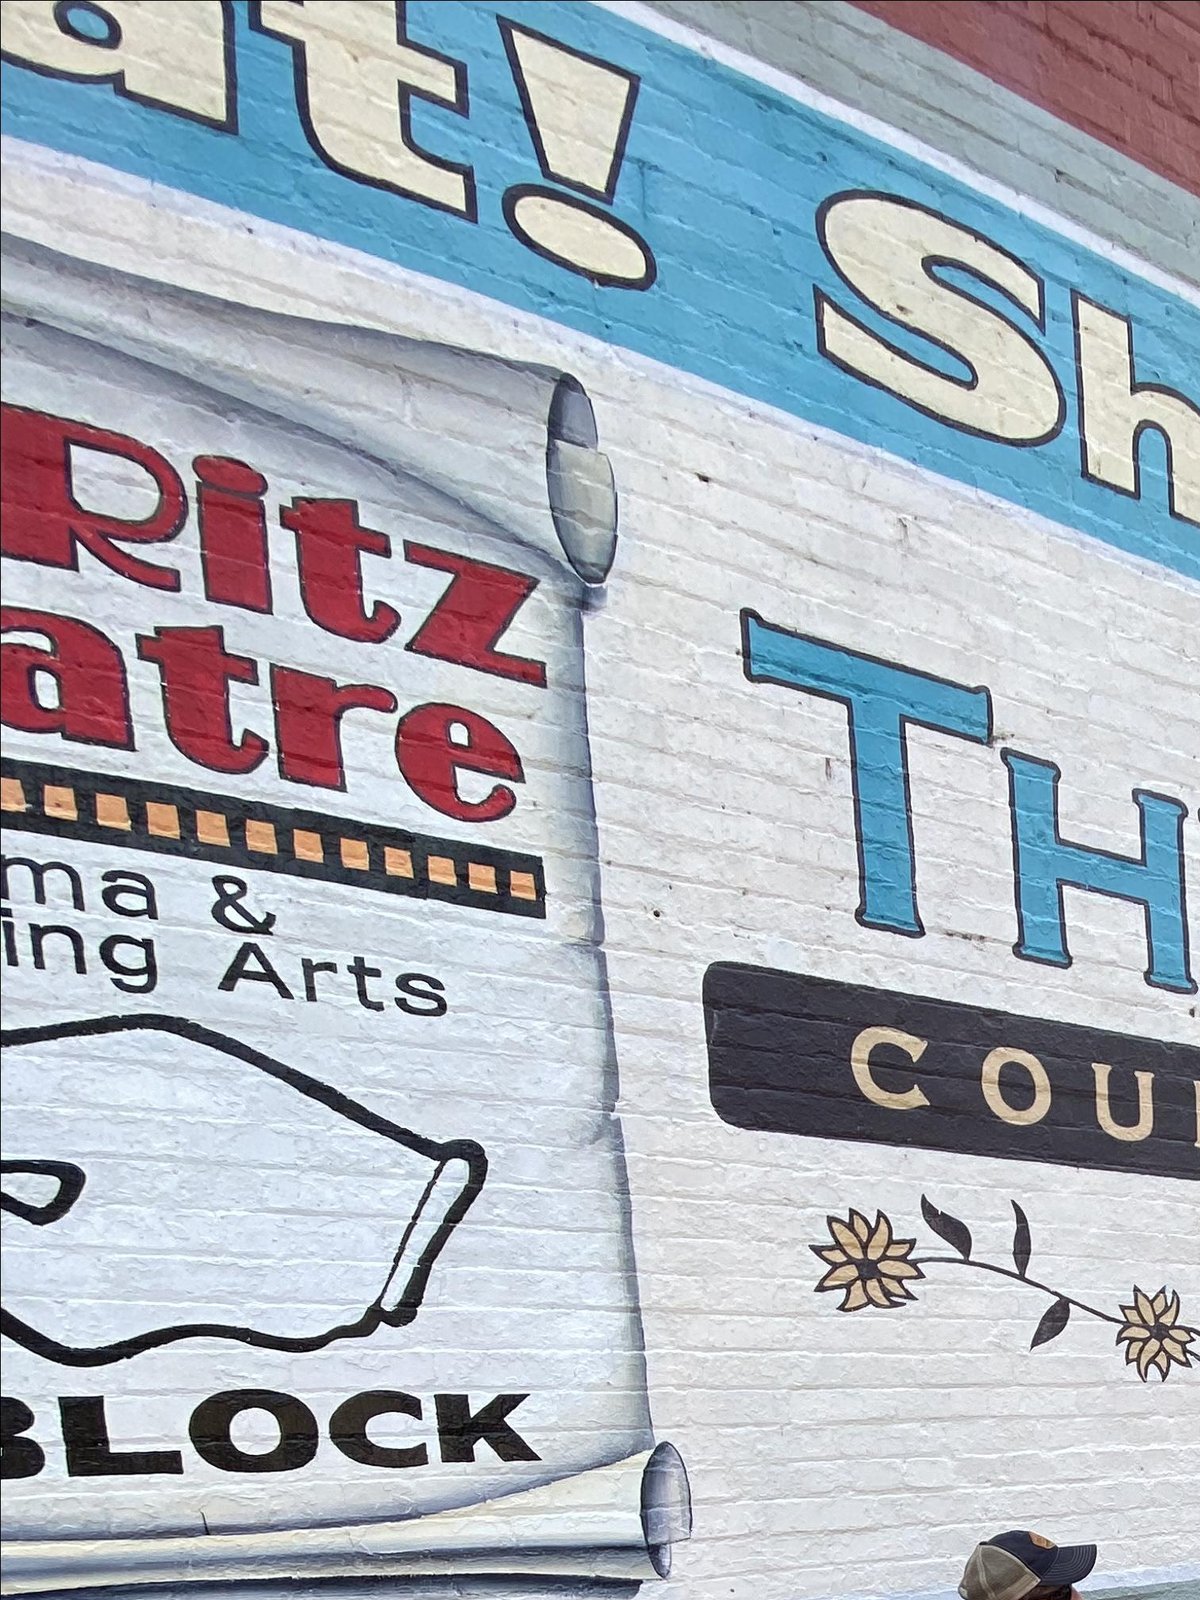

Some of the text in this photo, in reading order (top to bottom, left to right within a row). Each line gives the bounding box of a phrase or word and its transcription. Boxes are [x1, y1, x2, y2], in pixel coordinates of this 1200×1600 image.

[0, 403, 548, 688] Ritz
[0, 605, 525, 822] atre
[0, 853, 277, 935] ma &
[0, 907, 448, 1017] ing Arts
